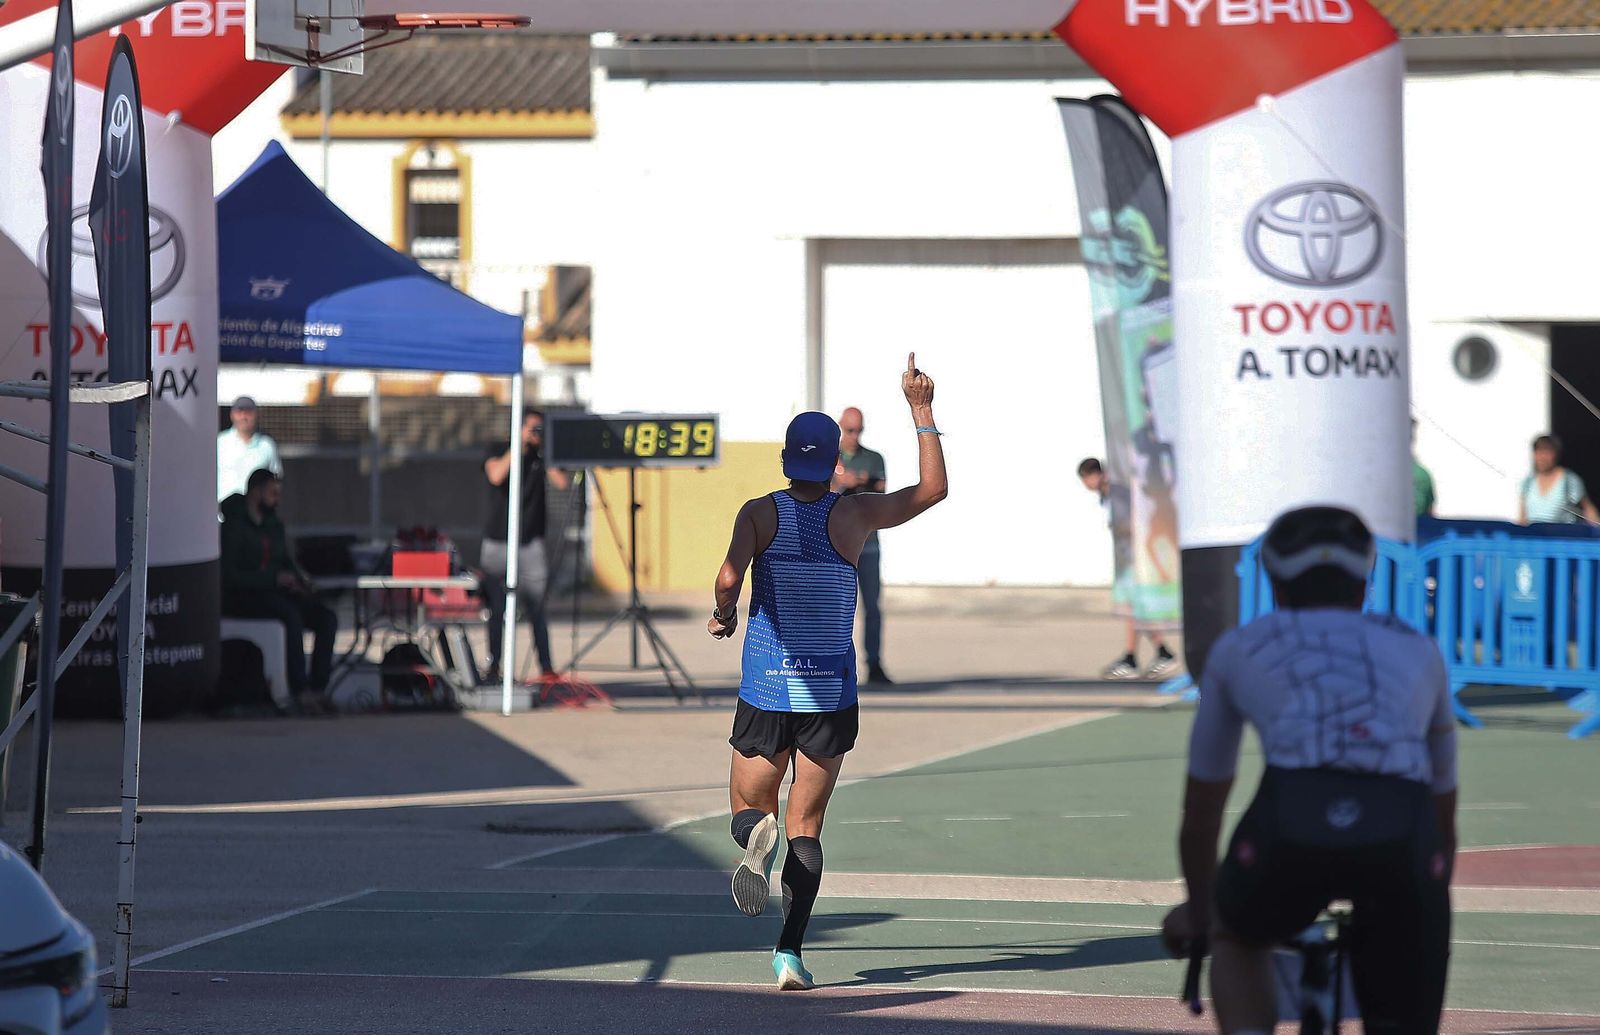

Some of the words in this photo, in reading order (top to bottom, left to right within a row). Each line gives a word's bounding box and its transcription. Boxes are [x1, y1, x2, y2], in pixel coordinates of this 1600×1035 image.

[108, 1, 246, 37] YBR
[1125, 0, 1354, 27] HYBRID
[260, 318, 277, 333] de
[280, 319, 343, 338] Algeciras
[1232, 300, 1396, 336] TOYOTA
[26, 322, 195, 358] TYTA
[1236, 350, 1272, 380] A.
[1278, 346, 1401, 379] TOMAX
[623, 421, 715, 457] 18:39
[144, 644, 204, 667] stepona
[782, 658, 818, 669] C.A.L.
